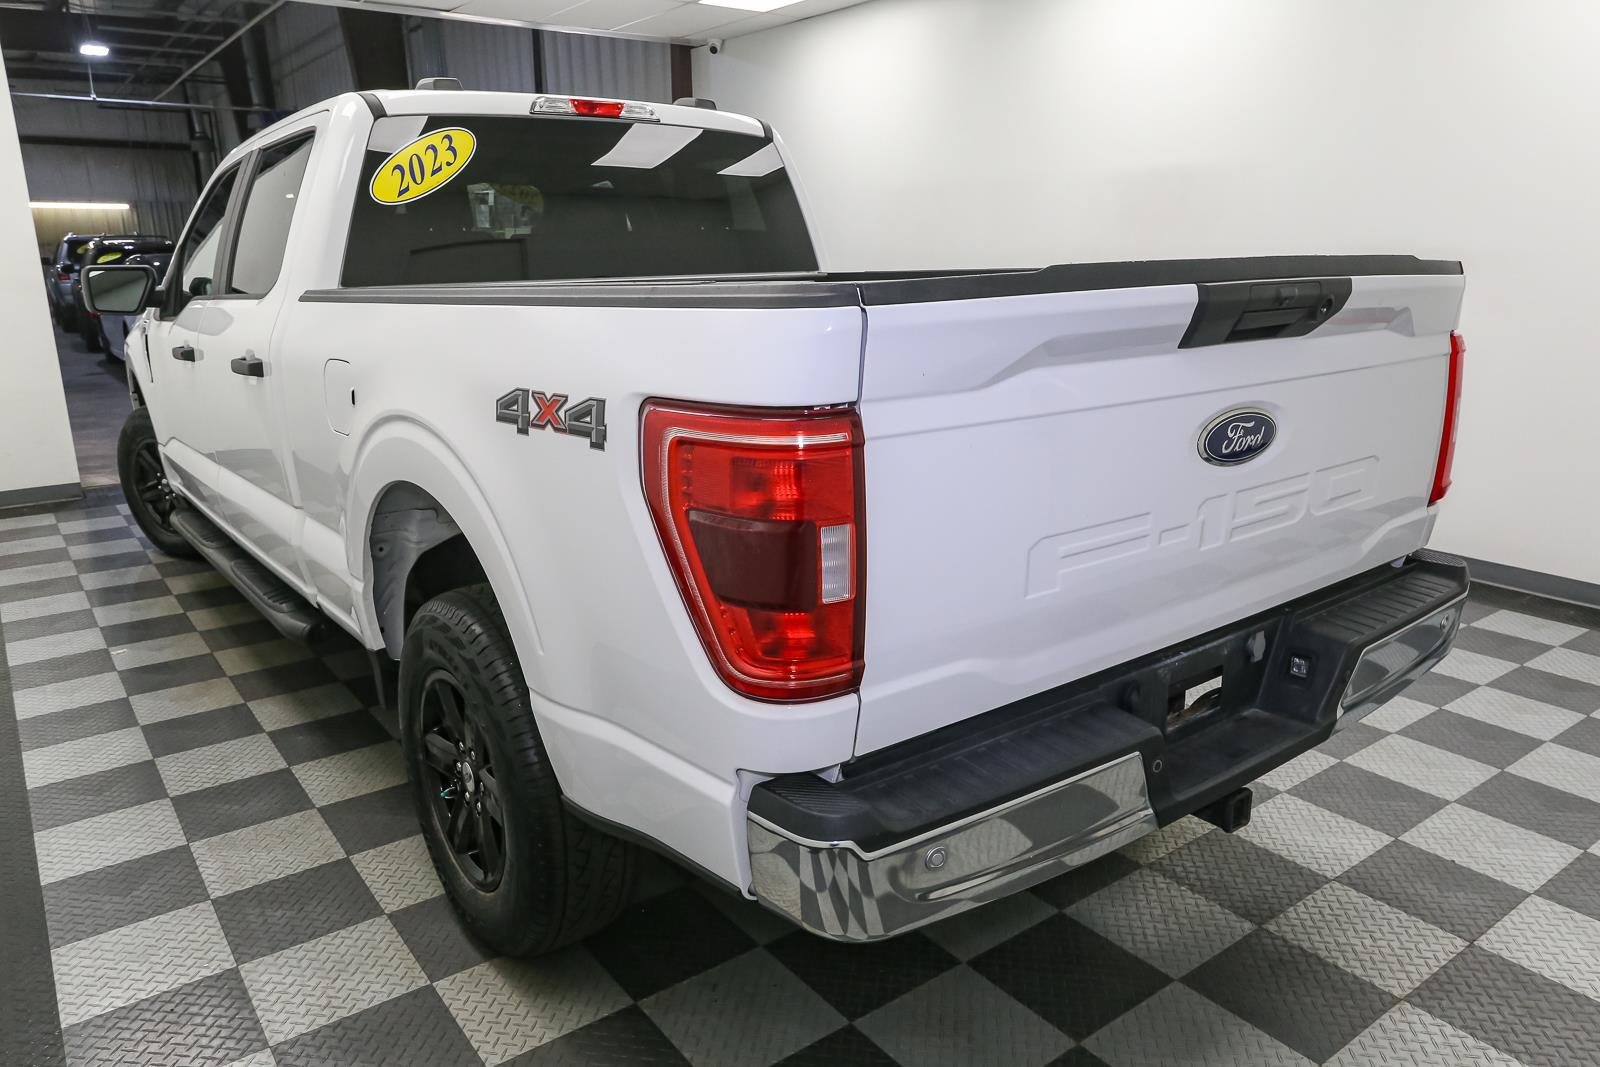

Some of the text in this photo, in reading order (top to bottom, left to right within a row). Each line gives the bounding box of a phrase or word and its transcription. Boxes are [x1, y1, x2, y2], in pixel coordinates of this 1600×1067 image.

[391, 134, 457, 198] 2023
[1222, 421, 1265, 453] Ford
[1025, 455, 1380, 600] F-150
